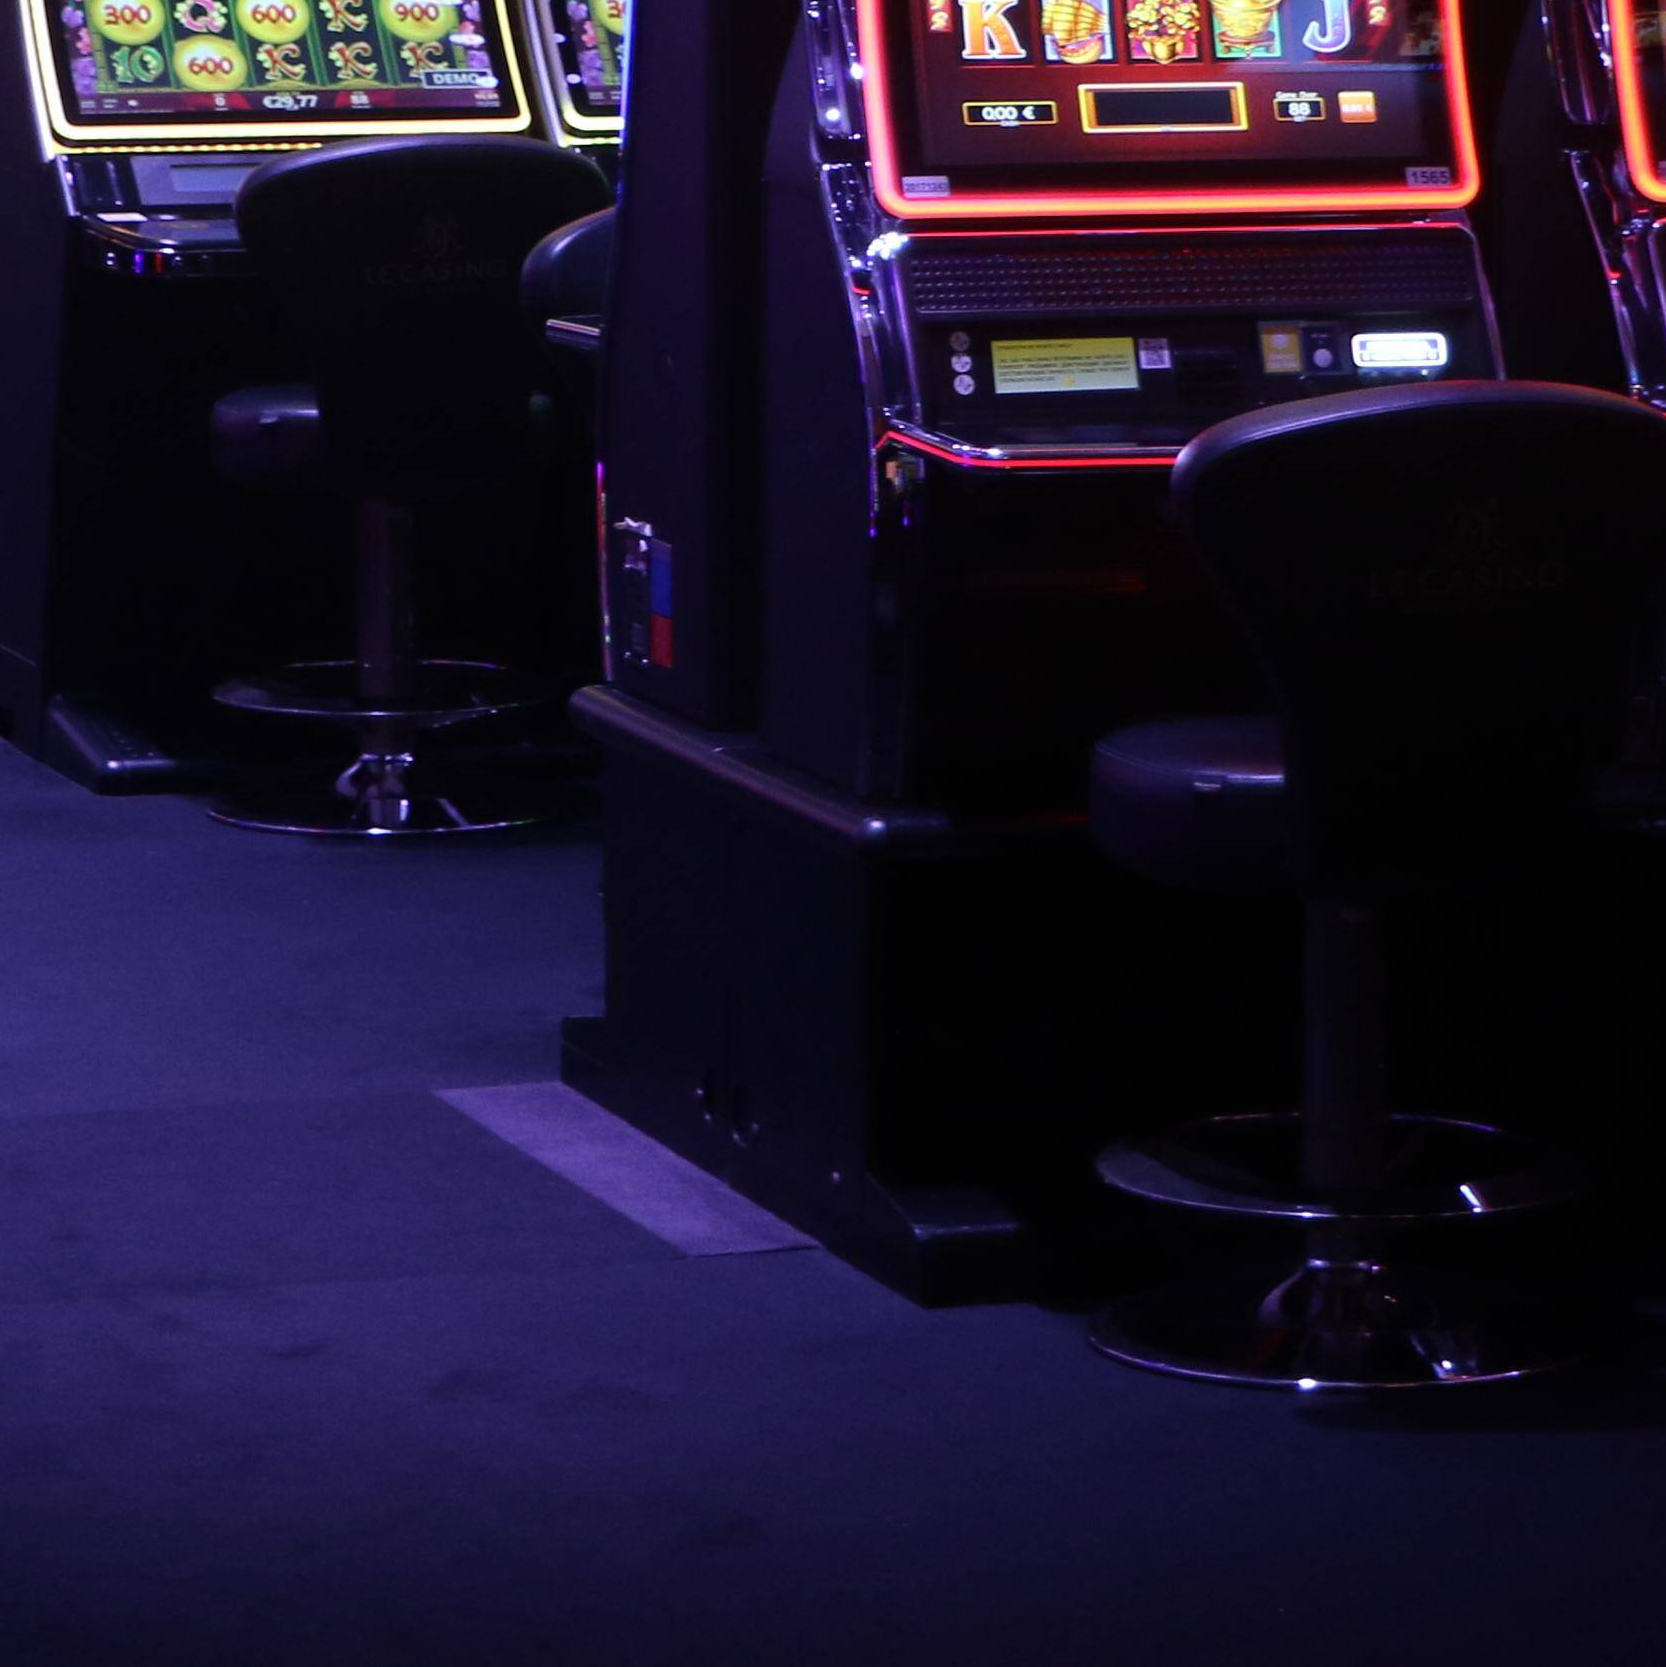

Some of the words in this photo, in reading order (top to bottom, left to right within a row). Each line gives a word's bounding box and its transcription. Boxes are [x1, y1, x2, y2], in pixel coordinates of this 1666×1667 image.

[104, 5, 151, 26] 300
[252, 5, 296, 24] 600
[397, 2, 439, 22] 900
[187, 57, 234, 76] 600
[433, 71, 479, 87] DEMO
[1288, 101, 1311, 117] 88
